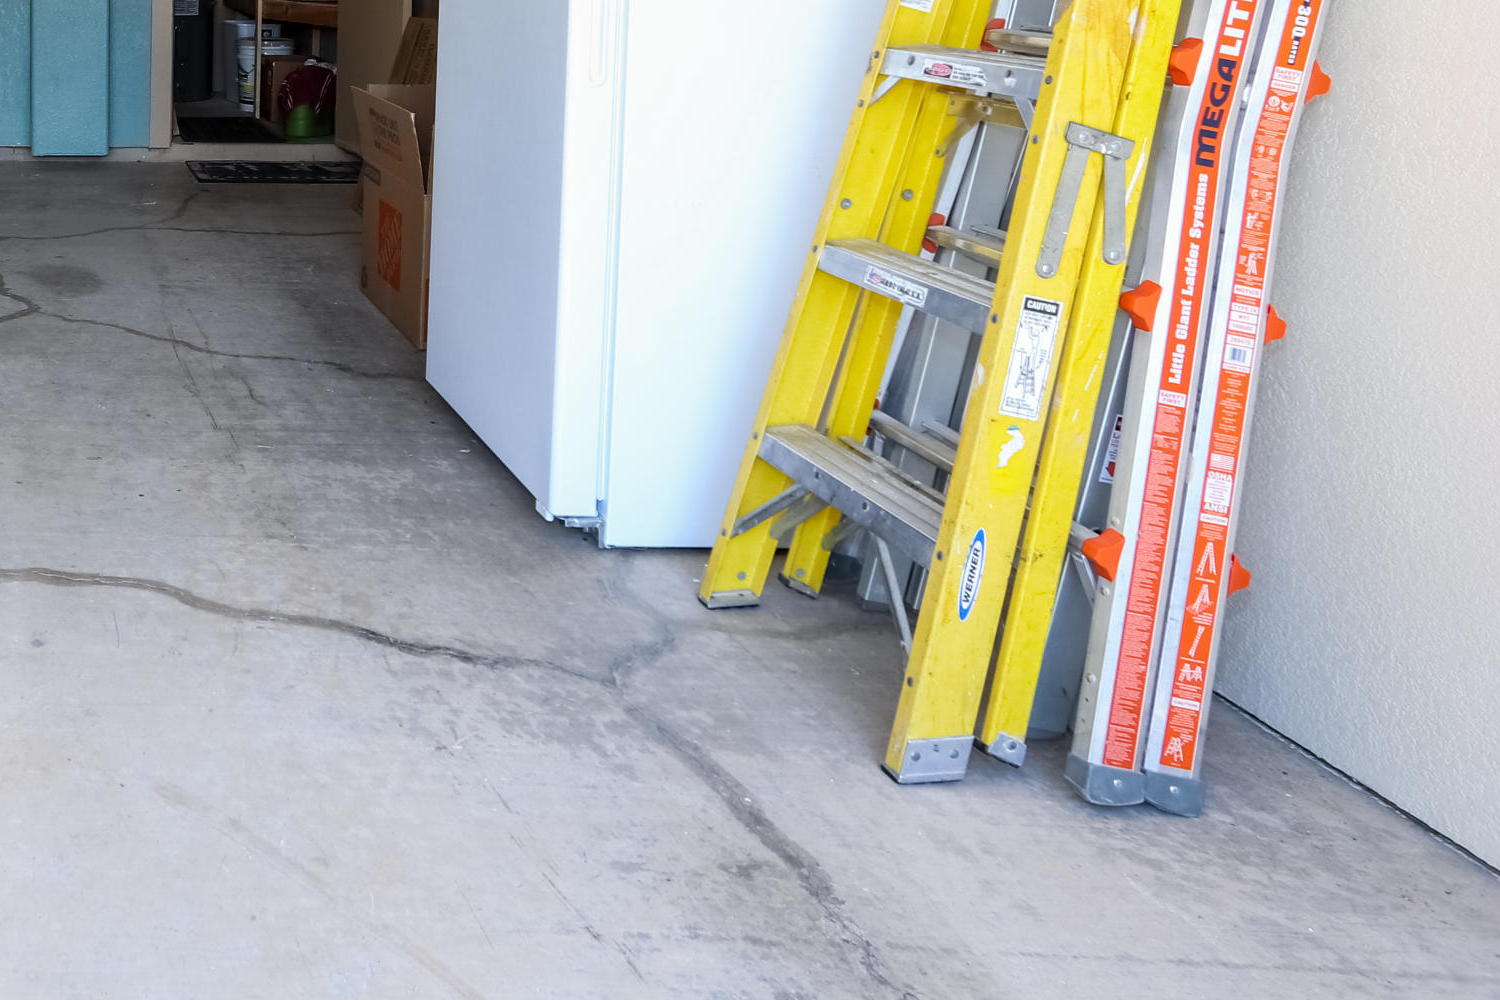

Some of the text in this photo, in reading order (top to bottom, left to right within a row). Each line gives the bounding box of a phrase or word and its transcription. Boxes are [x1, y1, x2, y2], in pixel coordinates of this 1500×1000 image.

[1292, 4, 1312, 38] 300
[1189, 172, 1209, 239] Systems
[1181, 242, 1200, 297] Ladder
[1027, 299, 1058, 314] CAUTION
[1175, 297, 1192, 341] Giant
[1168, 343, 1185, 385] Little
[1203, 502, 1228, 514] ANSI
[962, 547, 981, 603] WERNER
